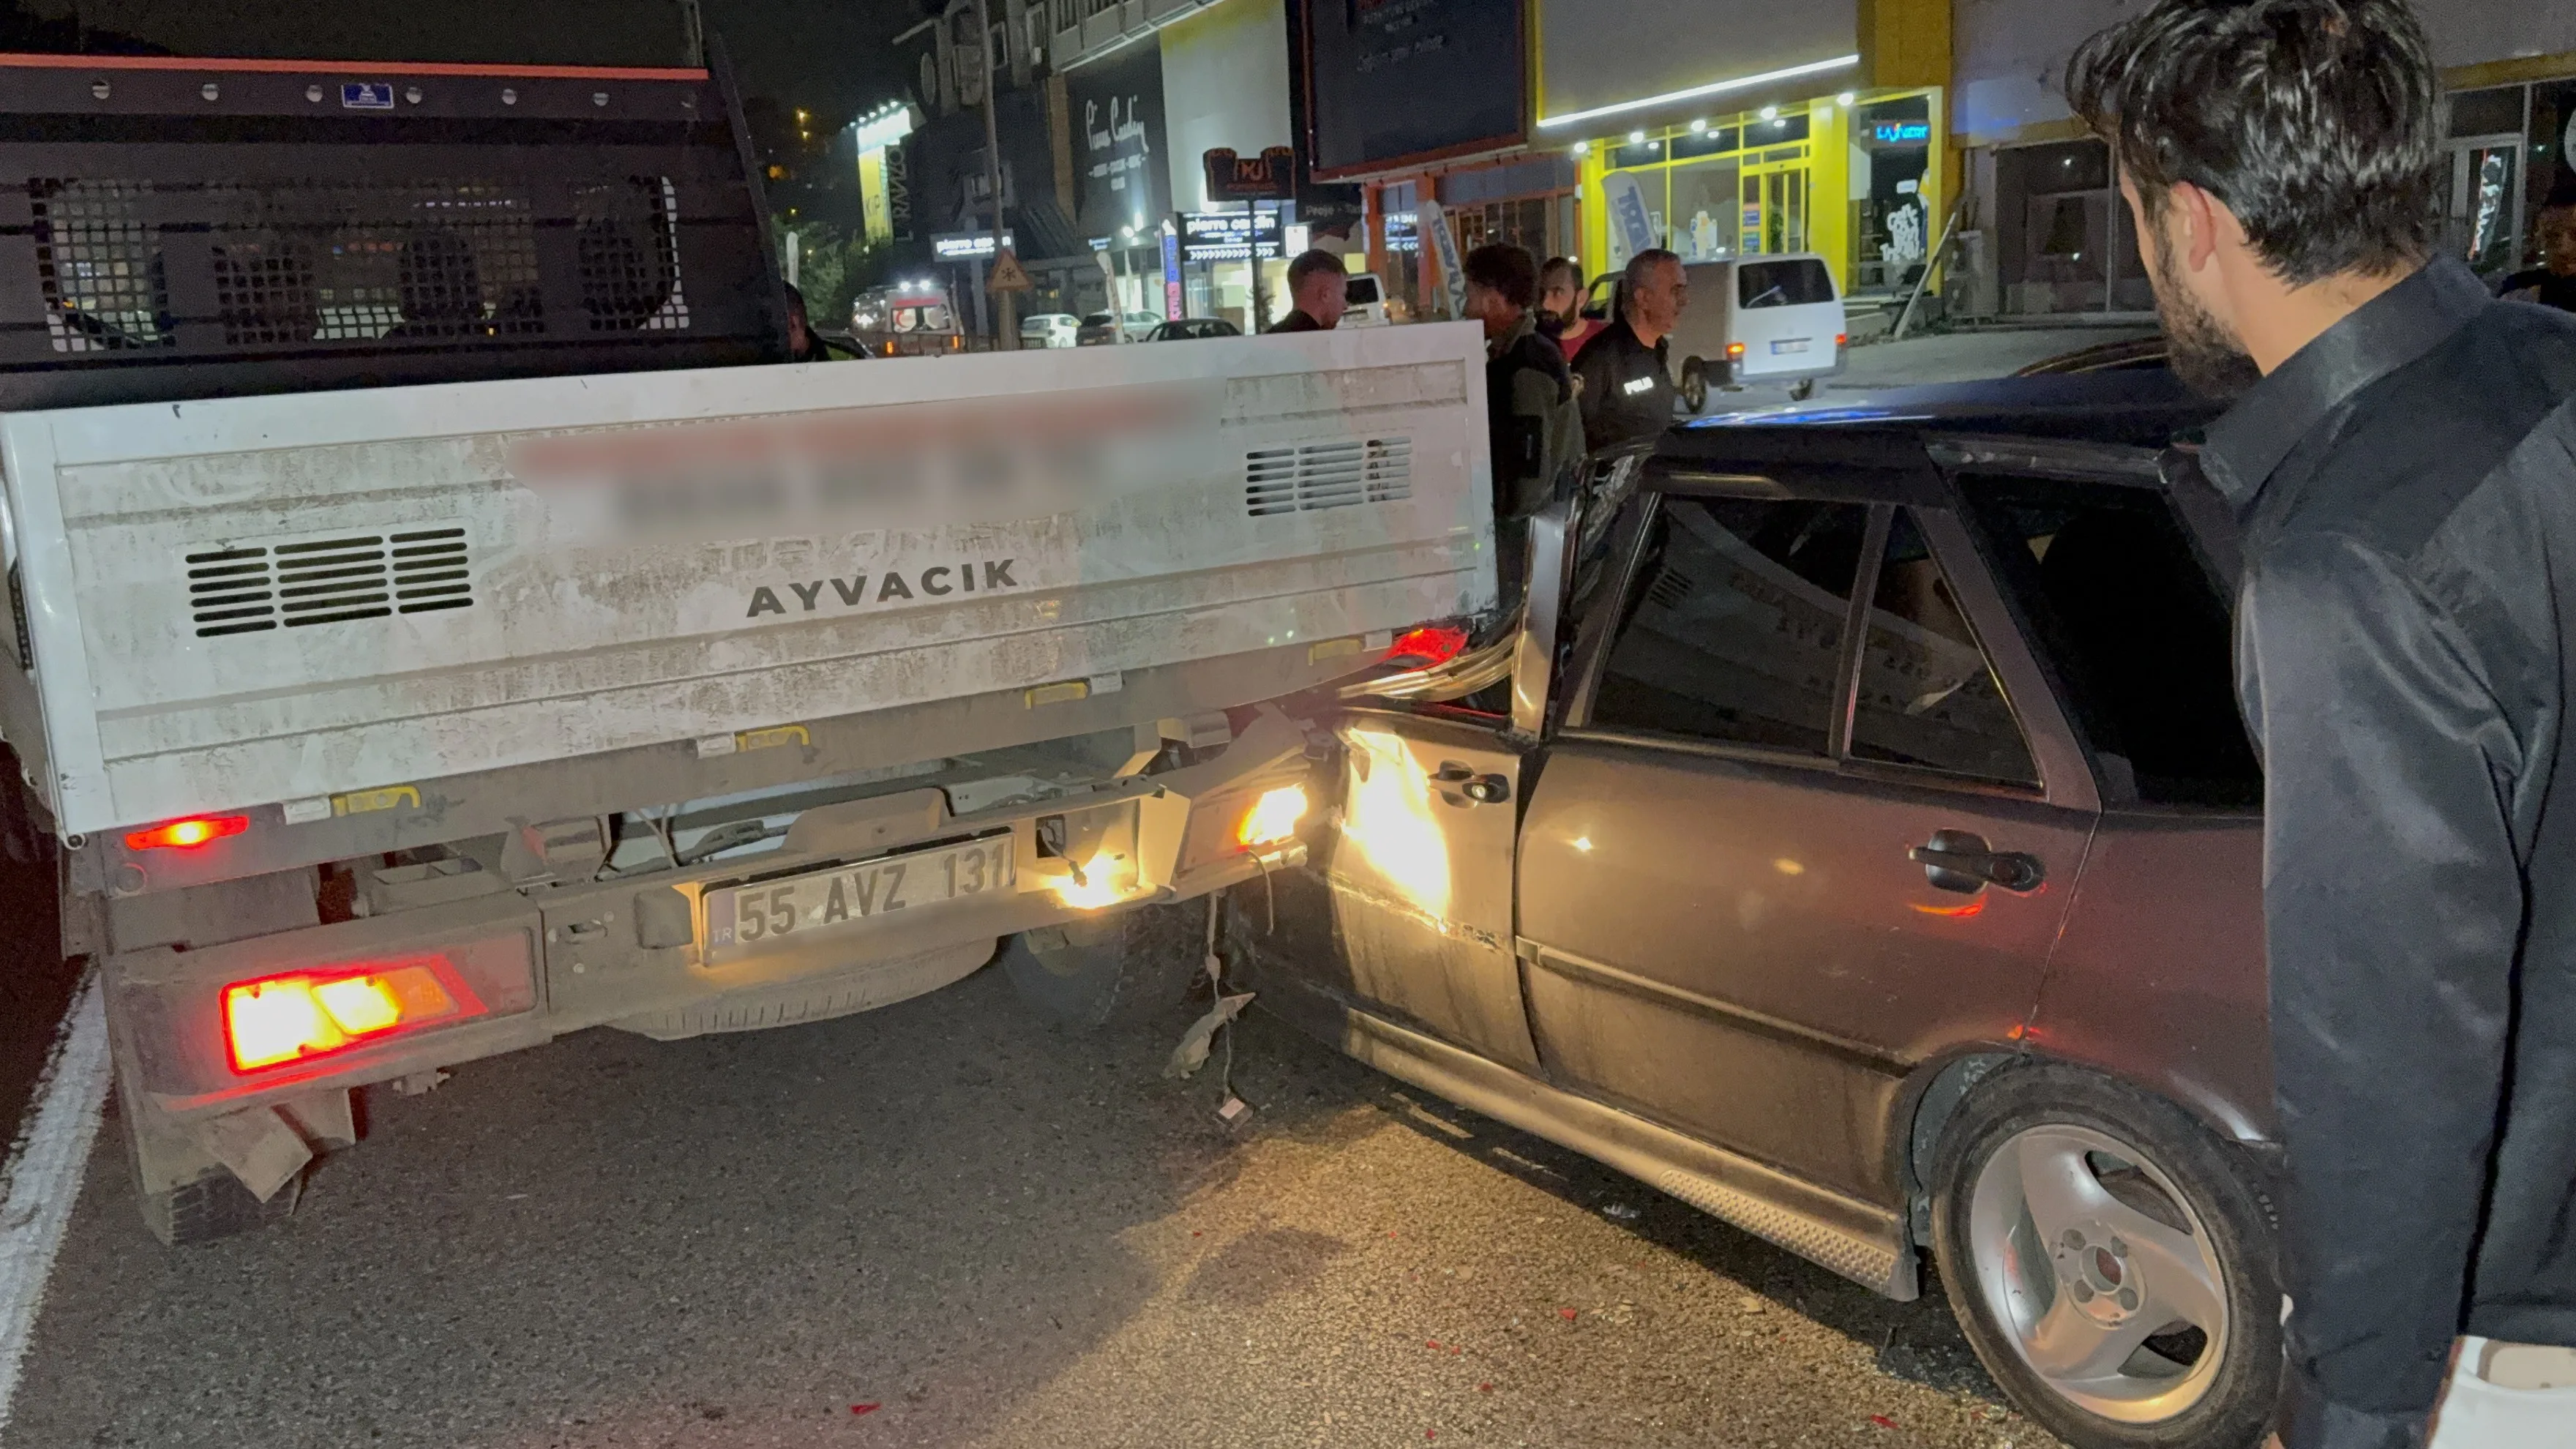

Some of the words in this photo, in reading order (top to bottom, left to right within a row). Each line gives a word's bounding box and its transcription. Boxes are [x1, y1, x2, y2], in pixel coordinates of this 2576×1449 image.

[746, 558, 1019, 618] AYVACIK
[739, 885, 796, 942] 55
[823, 863, 907, 924] AVZ
[943, 843, 1006, 899] 131
[713, 926, 732, 943] TR
